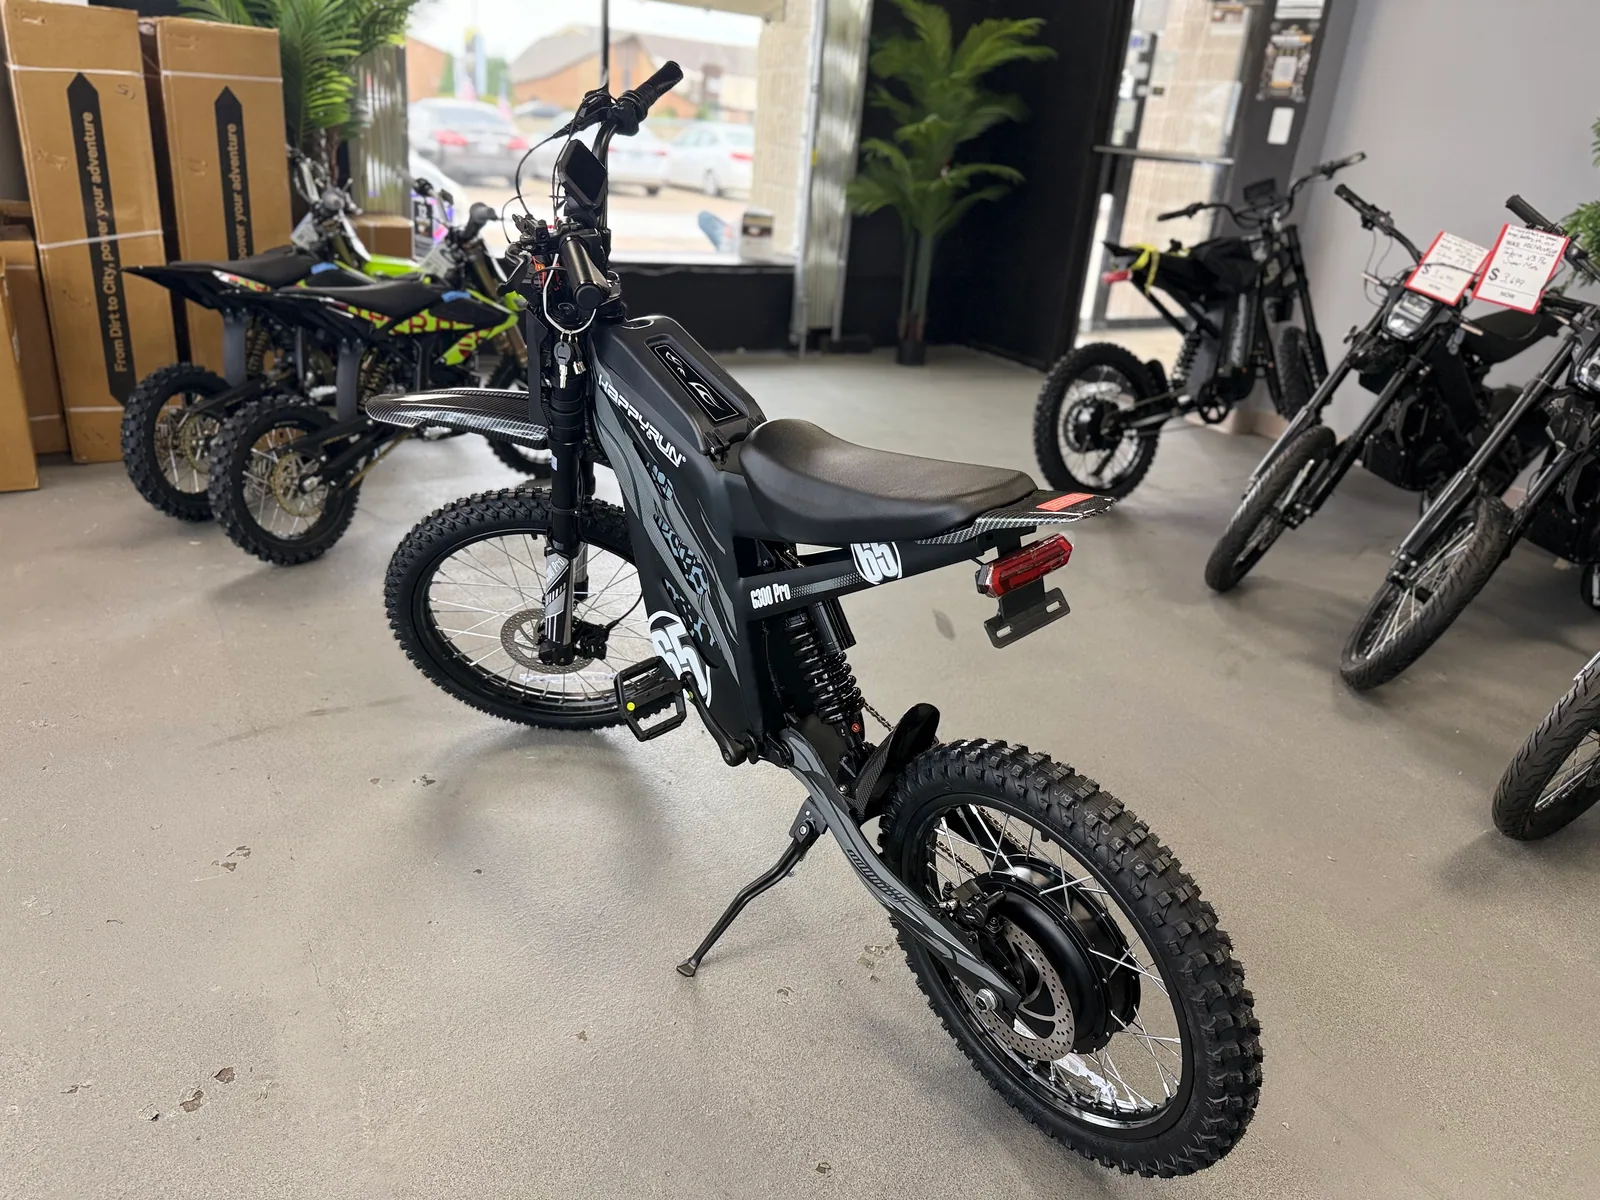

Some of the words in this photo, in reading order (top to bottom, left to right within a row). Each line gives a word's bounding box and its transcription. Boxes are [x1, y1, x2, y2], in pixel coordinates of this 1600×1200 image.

[82, 111, 102, 184] adventure
[227, 123, 242, 191] adventure
[93, 185, 109, 217] your
[233, 192, 247, 222] your
[103, 263, 117, 294] City,
[107, 296, 120, 311] to
[108, 311, 122, 338] Dirt
[114, 339, 128, 373] From
[855, 542, 898, 582] 65
[750, 585, 773, 609] G300
[772, 583, 791, 604] Pro
